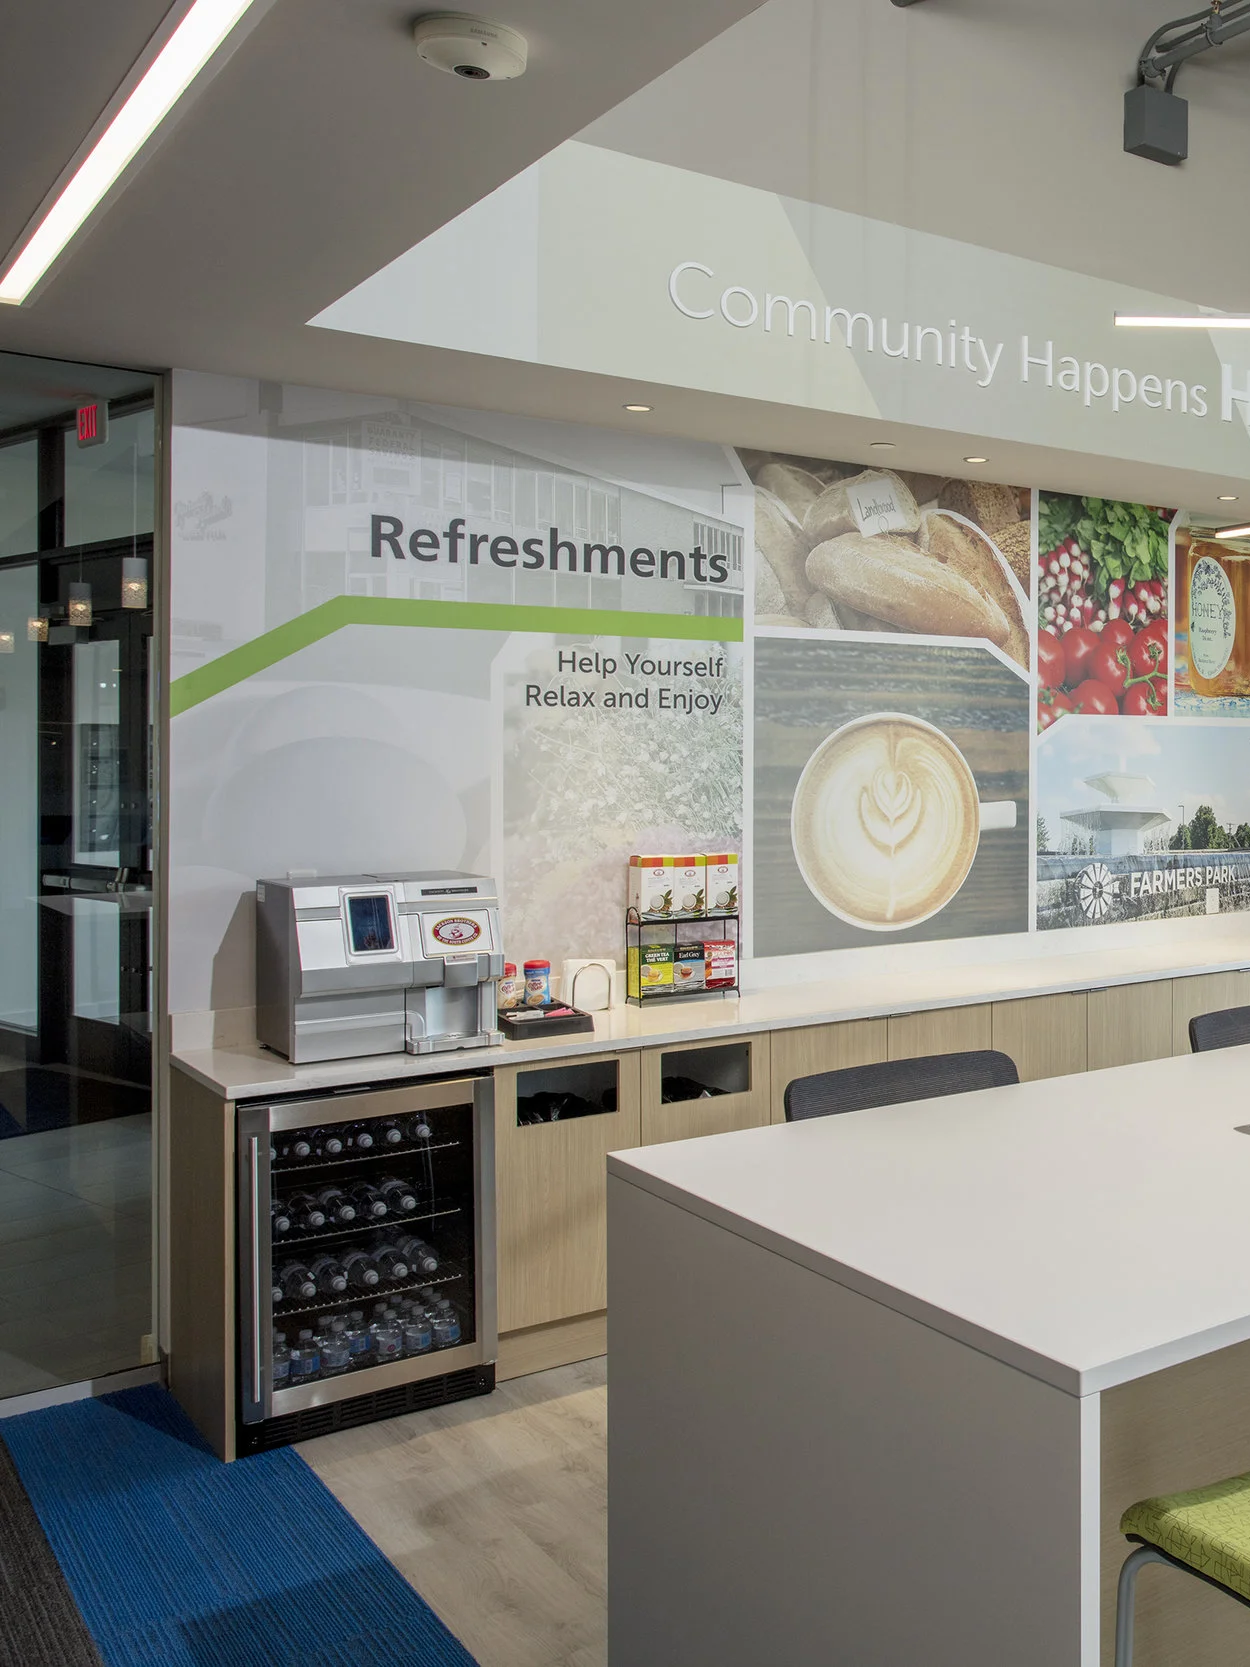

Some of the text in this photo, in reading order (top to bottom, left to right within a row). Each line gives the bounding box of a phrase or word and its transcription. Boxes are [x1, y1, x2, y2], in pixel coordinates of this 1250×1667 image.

[667, 261, 1003, 388] Community
[1021, 334, 1208, 418] Happens
[78, 404, 98, 441] EXIT
[370, 513, 729, 584] Refreshments
[1191, 602, 1223, 620] HONEY
[557, 650, 724, 679] Help Yourself
[525, 684, 723, 715] Relax and Enjoy
[1130, 864, 1238, 899] FARMERS PARK
